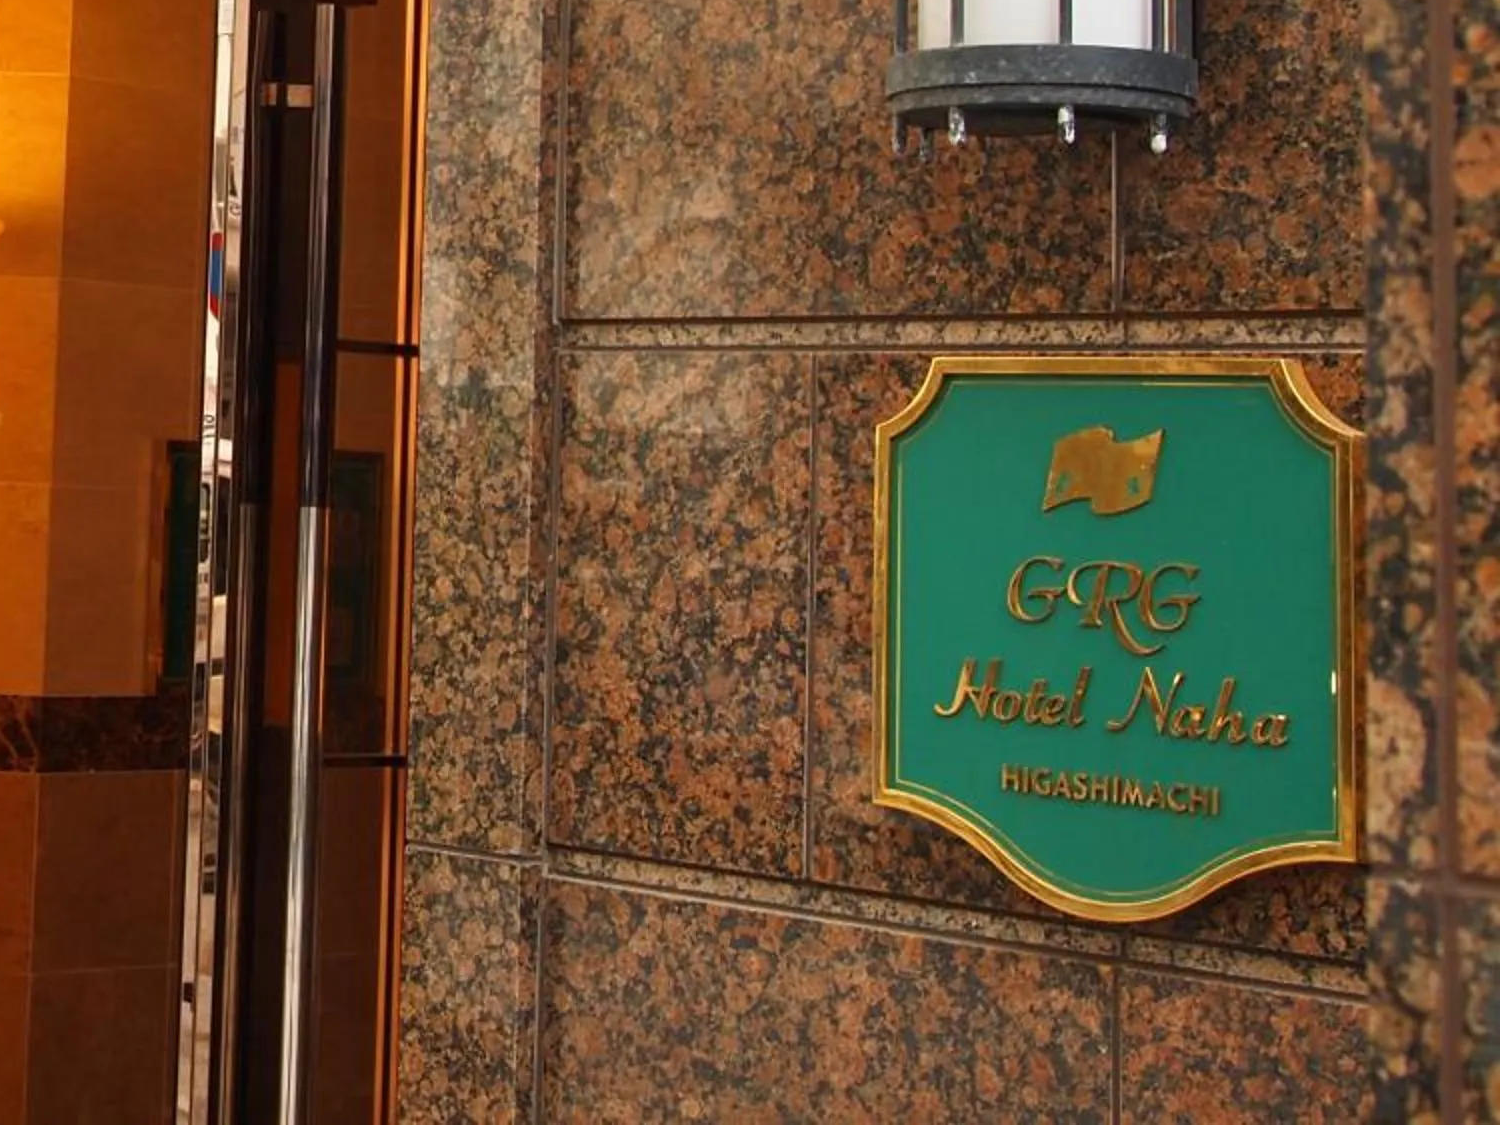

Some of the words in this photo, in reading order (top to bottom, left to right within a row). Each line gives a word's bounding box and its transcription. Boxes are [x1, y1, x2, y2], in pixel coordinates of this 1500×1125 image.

[1005, 555, 1200, 657] GRG
[933, 657, 1093, 729] Hotel
[1105, 666, 1291, 749] Naha
[999, 764, 1222, 817] HIGASHIMACHI
